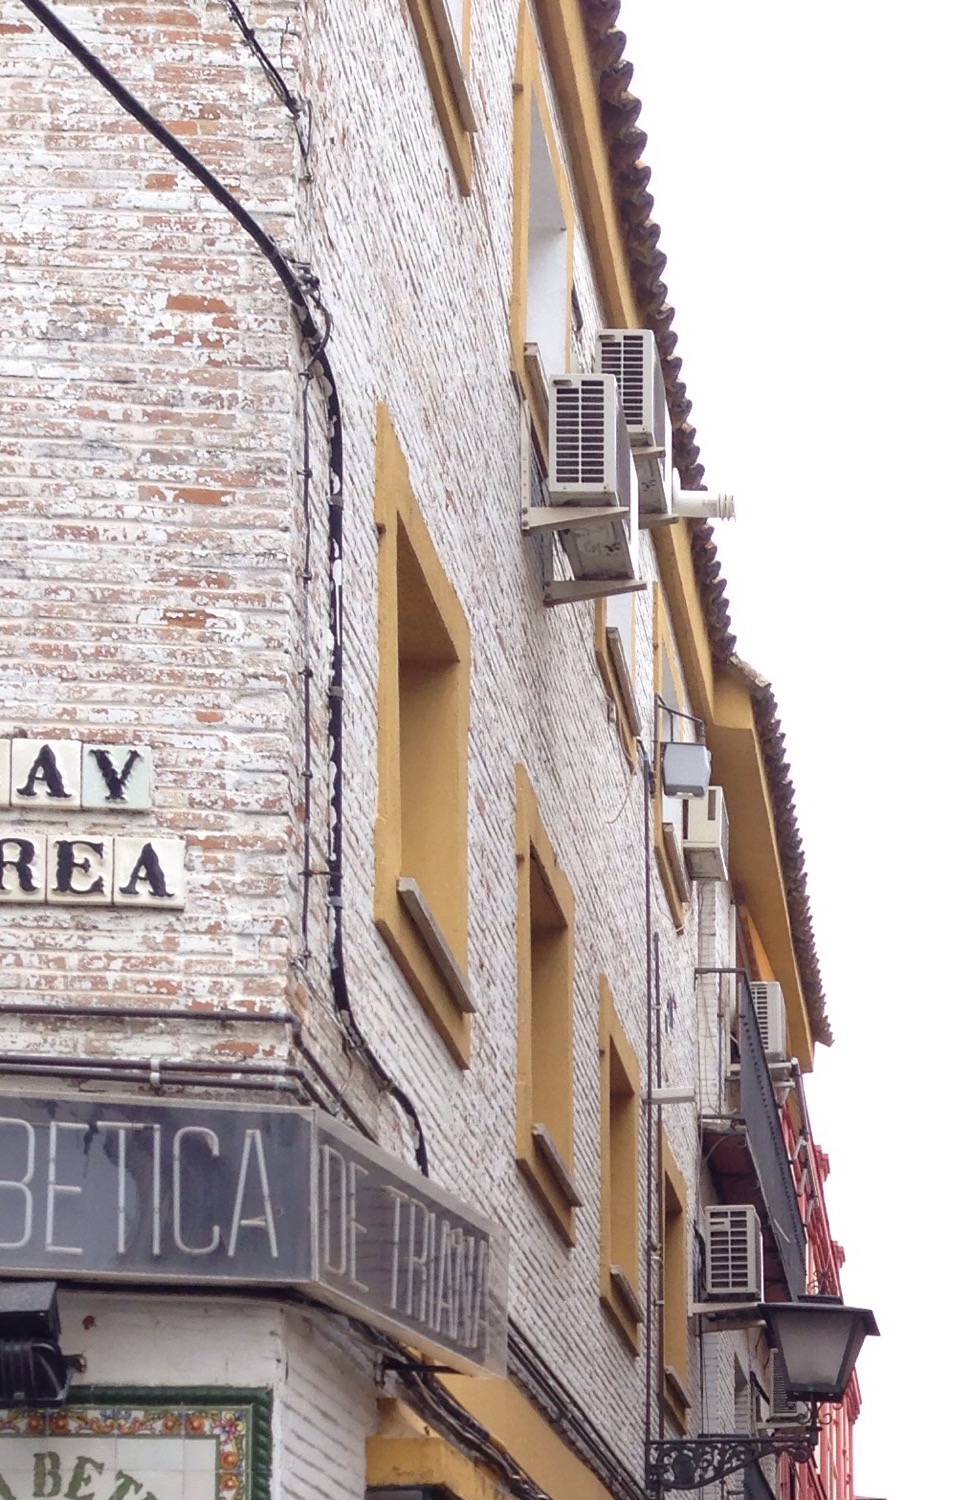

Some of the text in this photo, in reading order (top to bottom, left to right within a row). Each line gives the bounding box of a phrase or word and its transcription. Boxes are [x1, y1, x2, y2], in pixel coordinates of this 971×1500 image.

[16, 744, 144, 800] AY
[0, 838, 175, 897] REA
[322, 1144, 369, 1293] DE
